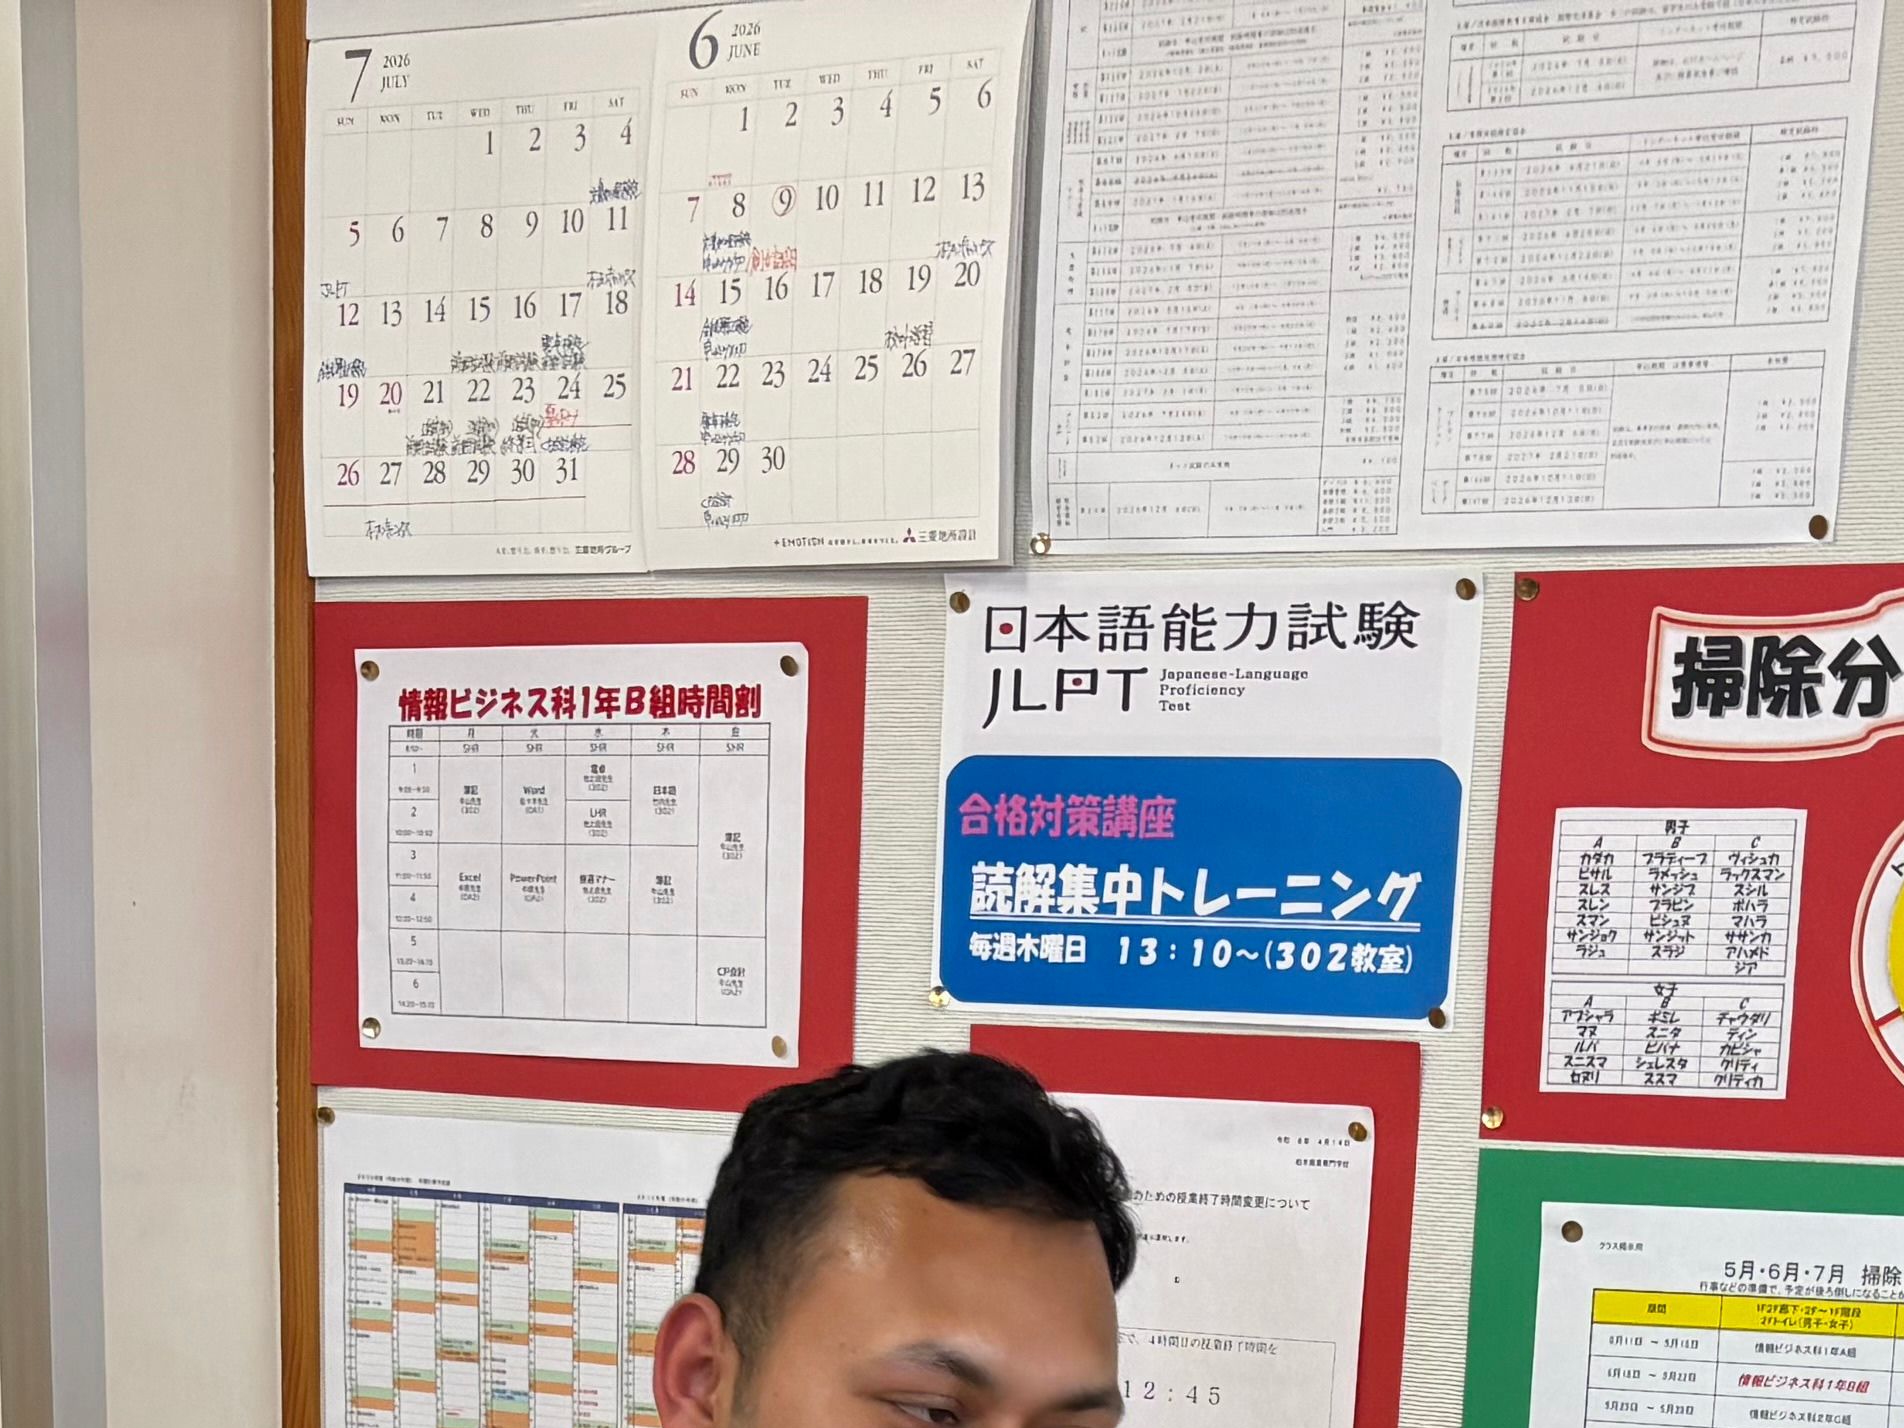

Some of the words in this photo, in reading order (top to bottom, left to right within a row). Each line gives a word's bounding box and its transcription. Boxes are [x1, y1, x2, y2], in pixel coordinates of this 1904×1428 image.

[731, 22, 760, 37] 2026
[689, 10, 722, 69] 6
[728, 43, 760, 61] JUNE
[383, 54, 410, 68] 2026
[346, 49, 372, 102] 7
[380, 75, 410, 92] JULY
[740, 107, 748, 132] 1
[786, 102, 798, 127] 2
[832, 98, 844, 126] 3
[880, 89, 893, 118] 4
[929, 87, 941, 115] 5
[978, 78, 992, 108] 6
[486, 131, 493, 154] 1
[530, 128, 541, 151] 2
[575, 124, 585, 151] 3
[620, 118, 632, 144] 4
[688, 196, 699, 223] 7
[732, 193, 745, 218] 8
[779, 188, 792, 215] 9
[816, 184, 839, 211] 10
[865, 181, 884, 207] 11
[913, 177, 935, 203] 12
[962, 172, 984, 201] 13
[350, 221, 360, 247] 5
[392, 216, 404, 242] 6
[437, 216, 448, 241] 7
[481, 214, 493, 238] 8
[526, 211, 538, 238] 9
[562, 208, 584, 234] 10
[608, 206, 628, 231] 11
[675, 278, 695, 307] 14
[720, 278, 741, 305] 15
[767, 273, 787, 301] 16
[813, 272, 834, 298] 17
[860, 268, 882, 294] 18
[908, 264, 931, 292] 19
[954, 261, 980, 287] 20
[339, 303, 359, 326] 12
[383, 301, 402, 326] 13
[426, 296, 445, 322] 14
[470, 296, 491, 322] 15
[514, 291, 536, 318] 16
[560, 292, 582, 318] 17
[607, 290, 628, 315] 18
[672, 367, 692, 391] 21
[717, 364, 740, 388] 22
[762, 361, 785, 388] 23
[808, 354, 831, 383] 24
[855, 355, 879, 381] 25
[902, 349, 927, 378] 26
[951, 349, 976, 375] 27
[338, 383, 359, 407] 19
[380, 382, 402, 406] 20
[424, 381, 443, 403] 21
[467, 379, 490, 403] 22
[512, 377, 535, 403] 23
[558, 372, 580, 400] 24
[604, 374, 626, 399] 25
[672, 450, 695, 474] 28
[717, 448, 739, 474] 29
[762, 446, 785, 473] 30
[337, 459, 359, 486] 26
[380, 461, 402, 485] 27
[424, 460, 446, 485] 28
[467, 459, 490, 486] 29
[512, 458, 534, 484] 30
[556, 457, 577, 485] 31
[985, 601, 1420, 652] 日本語能力試験
[1160, 668, 1308, 682] Japanese-Language
[1160, 684, 1246, 697] Proficiency
[398, 684, 761, 722] 情報ビジネス科1年B組時間割
[983, 667, 1148, 729] JLPT
[1160, 700, 1191, 712] Test
[523, 786, 545, 795] Word
[411, 807, 416, 816] 2
[959, 793, 1175, 838] 合格対策講座
[1665, 820, 1690, 834] 男子
[1593, 836, 1603, 849] A
[1671, 837, 1681, 849] B
[1751, 837, 1760, 849] C
[411, 850, 416, 860] 3
[459, 873, 481, 882] Excel
[1720, 868, 1785, 881] ラックスマン
[410, 893, 416, 901] 4
[970, 862, 1422, 922] 読解集中トレーニング
[1579, 884, 1610, 896] スレス
[1734, 884, 1768, 896] スシル
[1578, 899, 1610, 910] スレン
[1576, 915, 1610, 926] スマン
[1732, 916, 1767, 928] マハラ
[411, 936, 416, 946] 5
[1725, 932, 1771, 943] ササンカ
[970, 932, 1086, 964] 毎週木曜日
[1576, 945, 1605, 958] ラジュ
[1652, 946, 1685, 958] スラジ
[413, 979, 418, 988] 6
[1654, 983, 1678, 996] 女子
[1584, 995, 1593, 1006] A
[1661, 997, 1669, 1008] B
[1740, 998, 1749, 1009] C
[1647, 1027, 1681, 1039] スニタ
[1564, 1056, 1607, 1067] スニスマ
[1636, 1058, 1688, 1069] シェレスタ
[1645, 1073, 1677, 1084] ススマ
[1724, 1260, 1845, 1285] 5月・6月・7月
[1738, 1373, 1870, 1393] 情報ビジネス科1年B組
